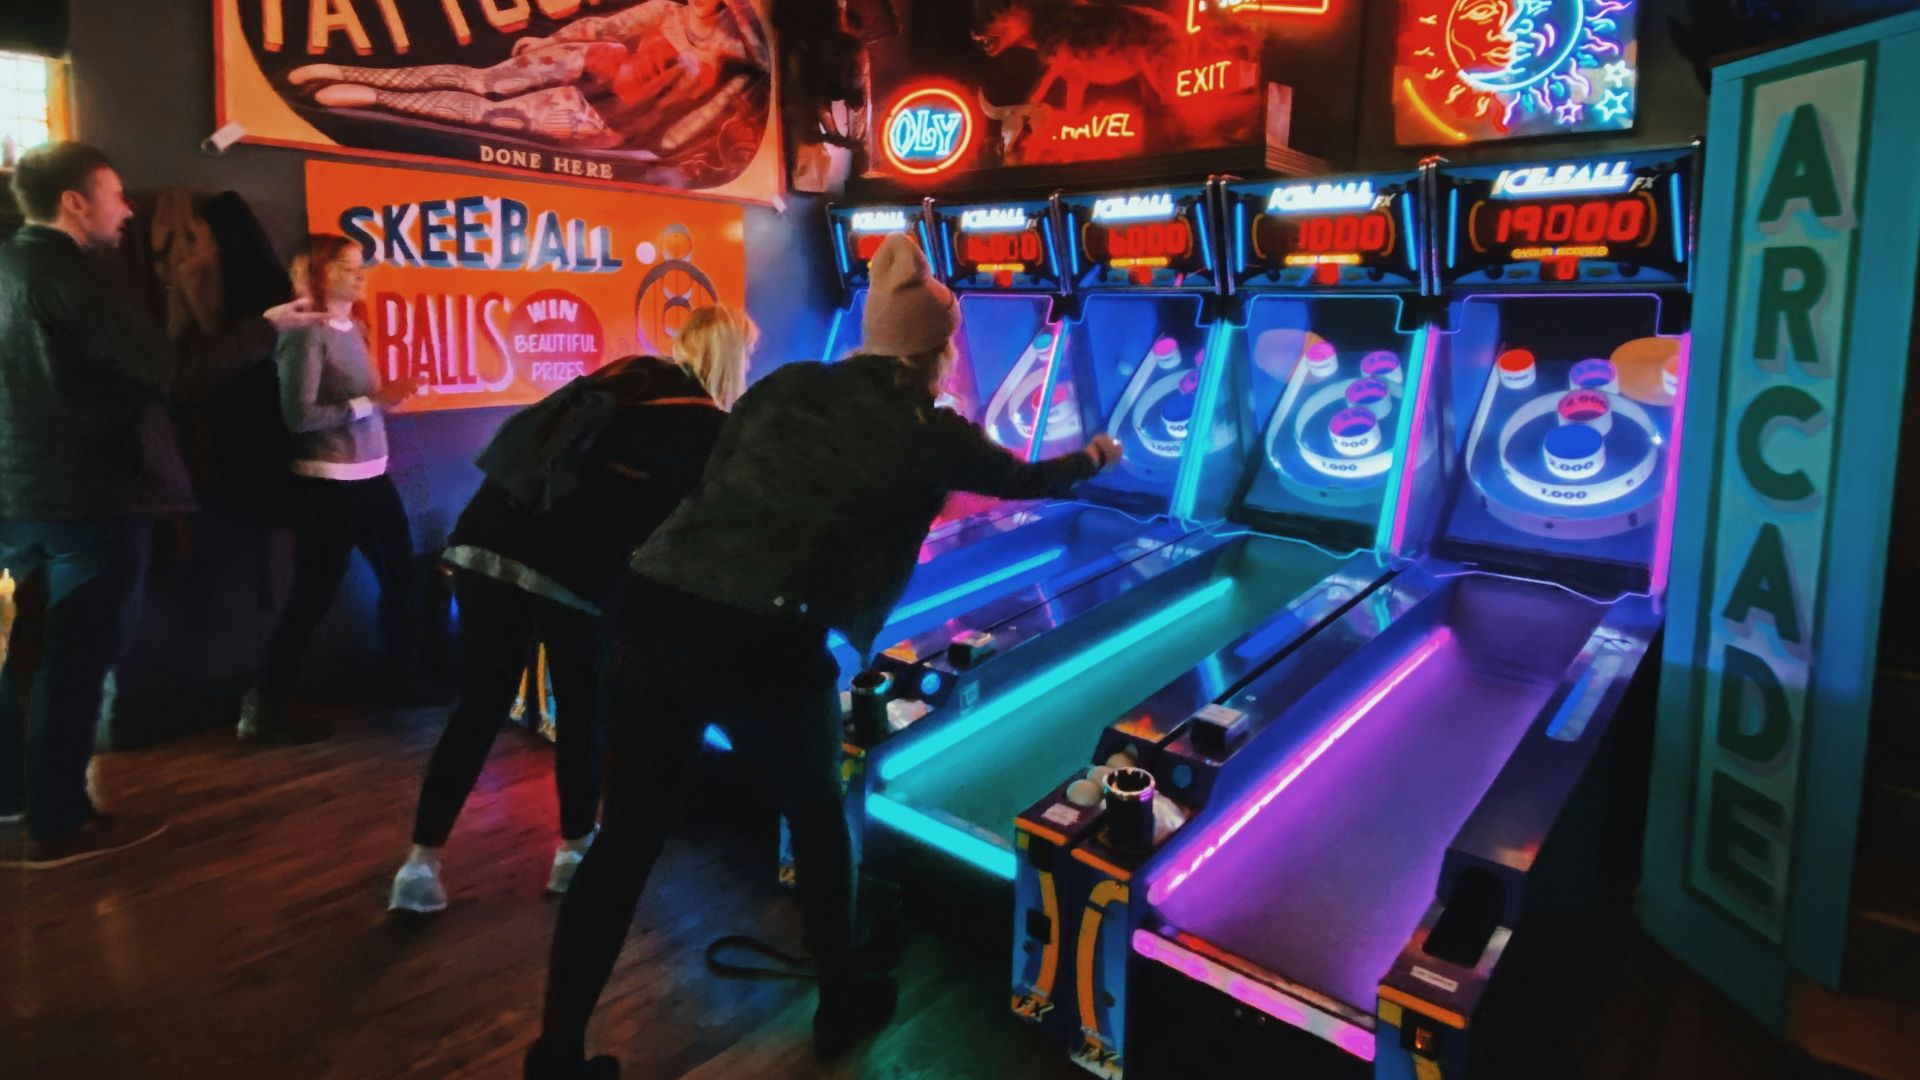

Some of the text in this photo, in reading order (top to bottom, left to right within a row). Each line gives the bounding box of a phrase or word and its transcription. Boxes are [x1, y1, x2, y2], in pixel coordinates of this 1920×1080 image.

[1176, 61, 1232, 97] EXIT
[889, 108, 963, 158] OLY
[479, 145, 614, 180] DONE HERE
[1496, 200, 1645, 243] 19000
[526, 299, 579, 323] WIN
[514, 333, 598, 354] BEAUTIFUL
[531, 360, 585, 382] PRIZES
[1704, 102, 1852, 914] ARCADE
